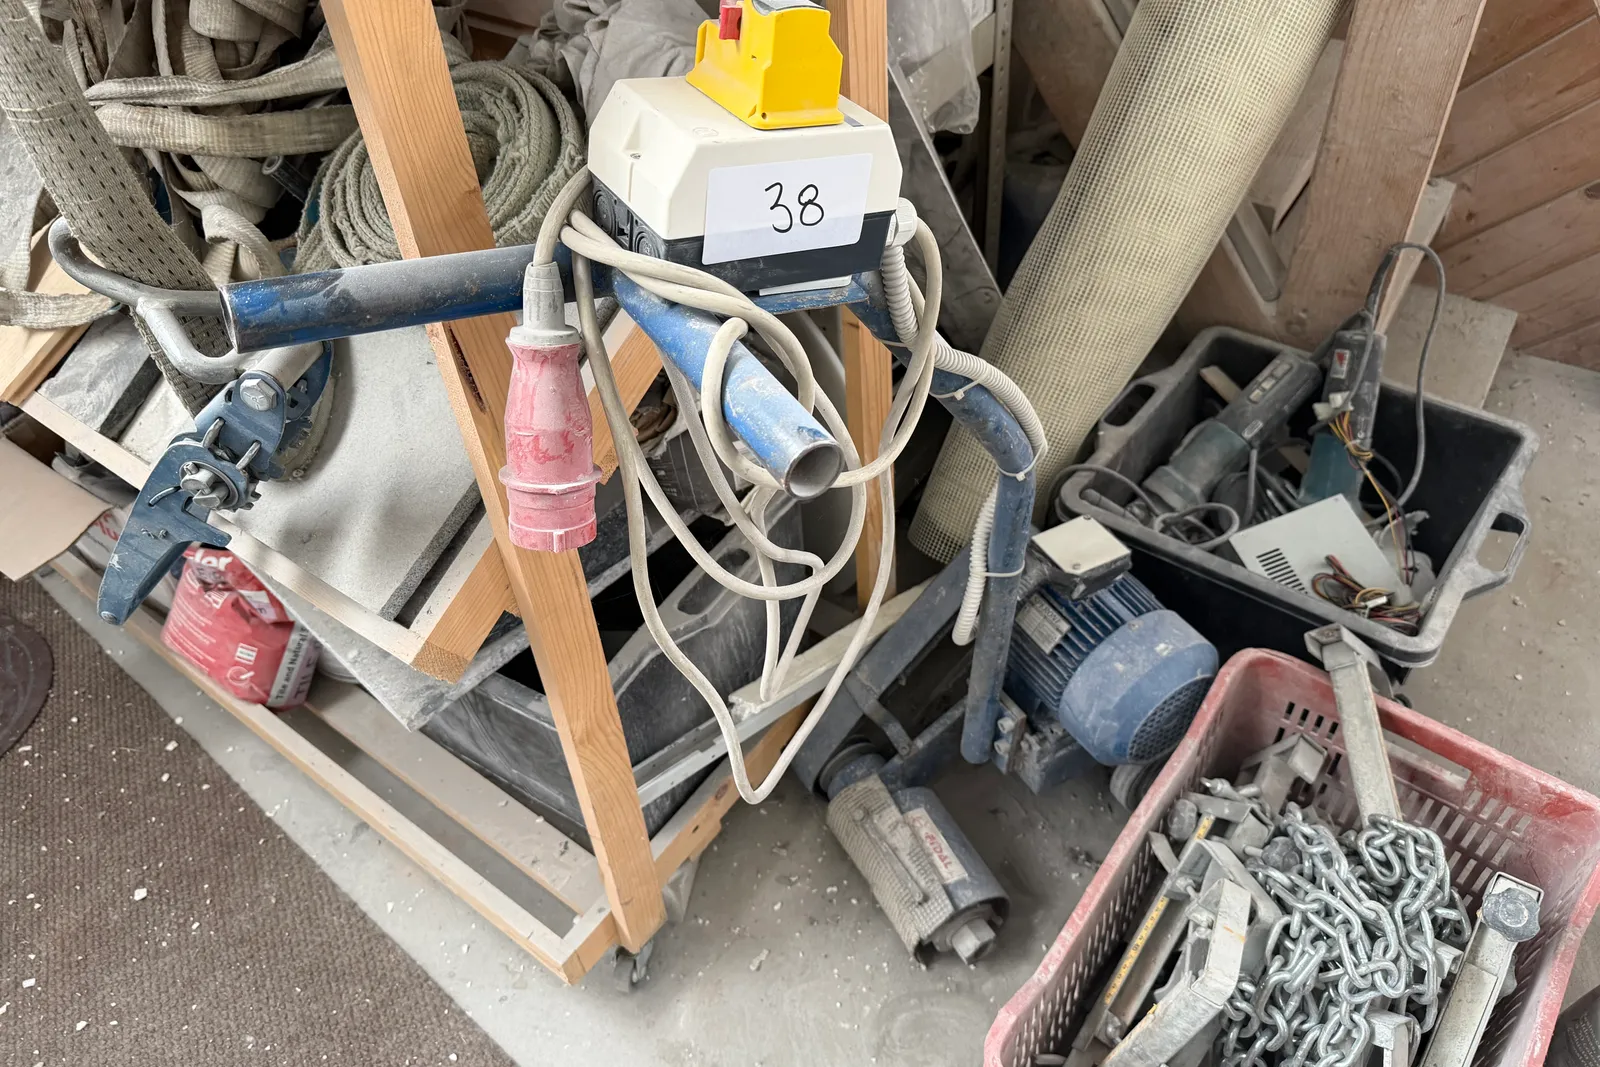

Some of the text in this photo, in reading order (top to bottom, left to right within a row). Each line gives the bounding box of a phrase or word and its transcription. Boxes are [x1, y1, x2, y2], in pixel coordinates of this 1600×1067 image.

[764, 181, 825, 234] 38
[288, 633, 309, 665] Natural
[285, 667, 295, 682] and
[275, 683, 288, 699] Tile
